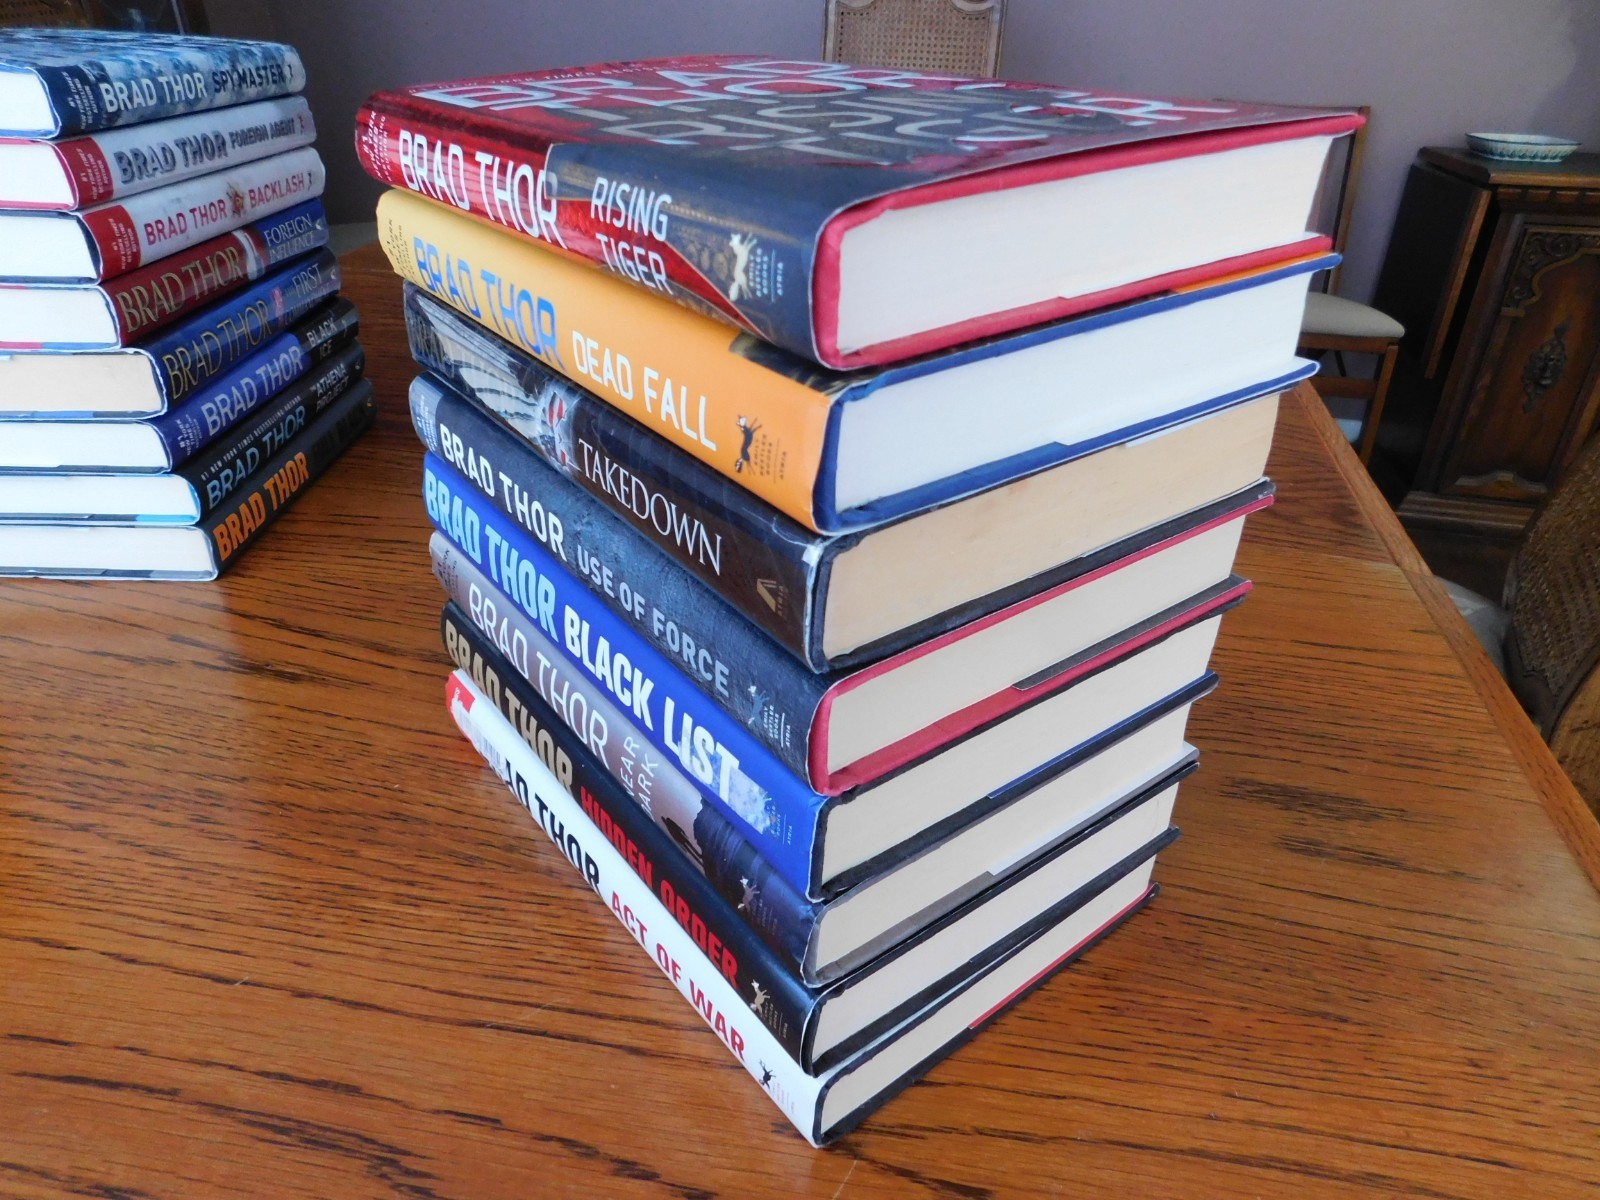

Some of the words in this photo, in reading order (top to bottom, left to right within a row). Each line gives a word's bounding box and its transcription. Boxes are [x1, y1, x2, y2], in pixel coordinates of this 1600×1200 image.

[101, 78, 157, 113] BRAD
[161, 71, 207, 102] THOR
[212, 64, 285, 93] SPYMASTER
[413, 60, 852, 109] BRAD
[114, 143, 176, 184] BRAD
[176, 130, 229, 169] THOR
[229, 123, 268, 151] FOREIGN
[143, 210, 188, 246] BRAD
[190, 199, 227, 234] THOR
[248, 176, 305, 211] BACKLASH
[399, 129, 470, 211] BRAD
[475, 151, 567, 249] THOR
[590, 176, 672, 242] RISING
[115, 269, 185, 333] BRAD
[182, 245, 243, 298] THOR
[264, 213, 313, 247] FOREIGN
[596, 232, 673, 294] TIGER
[162, 331, 223, 401] BRAD
[217, 299, 272, 365] THOR
[292, 263, 322, 298] FIRST
[200, 368, 258, 436] BRAD
[260, 344, 305, 395] THOR
[306, 317, 337, 348] BLACK
[316, 363, 347, 397] ATHENA
[413, 237, 482, 320] BRAD
[480, 269, 569, 373] THOR
[572, 330, 634, 401] DEAD
[643, 367, 717, 451] FALL
[206, 447, 260, 509] BRAD
[262, 405, 305, 457] THOR
[213, 492, 266, 561] BRAD
[263, 452, 310, 511] THOR
[579, 438, 723, 576] TAKEDOWN
[440, 423, 495, 497] BRAD
[499, 471, 567, 561] THOR
[578, 545, 615, 598] USE
[620, 582, 645, 624] OF
[652, 608, 729, 697] FORCE
[425, 468, 482, 565] BRAD
[485, 524, 559, 642] THOR
[564, 604, 654, 731] BLACK
[664, 696, 740, 803] LIST
[469, 583, 529, 680] BRAD
[536, 651, 610, 769] THOR
[446, 619, 501, 709] BRAD
[505, 687, 573, 796] THOR
[581, 786, 653, 888] HIDDEN
[661, 880, 740, 990] ORDER
[535, 792, 601, 895] THOR
[611, 890, 648, 946] ACT
[656, 943, 682, 983] OF
[689, 978, 746, 1061] WAR
